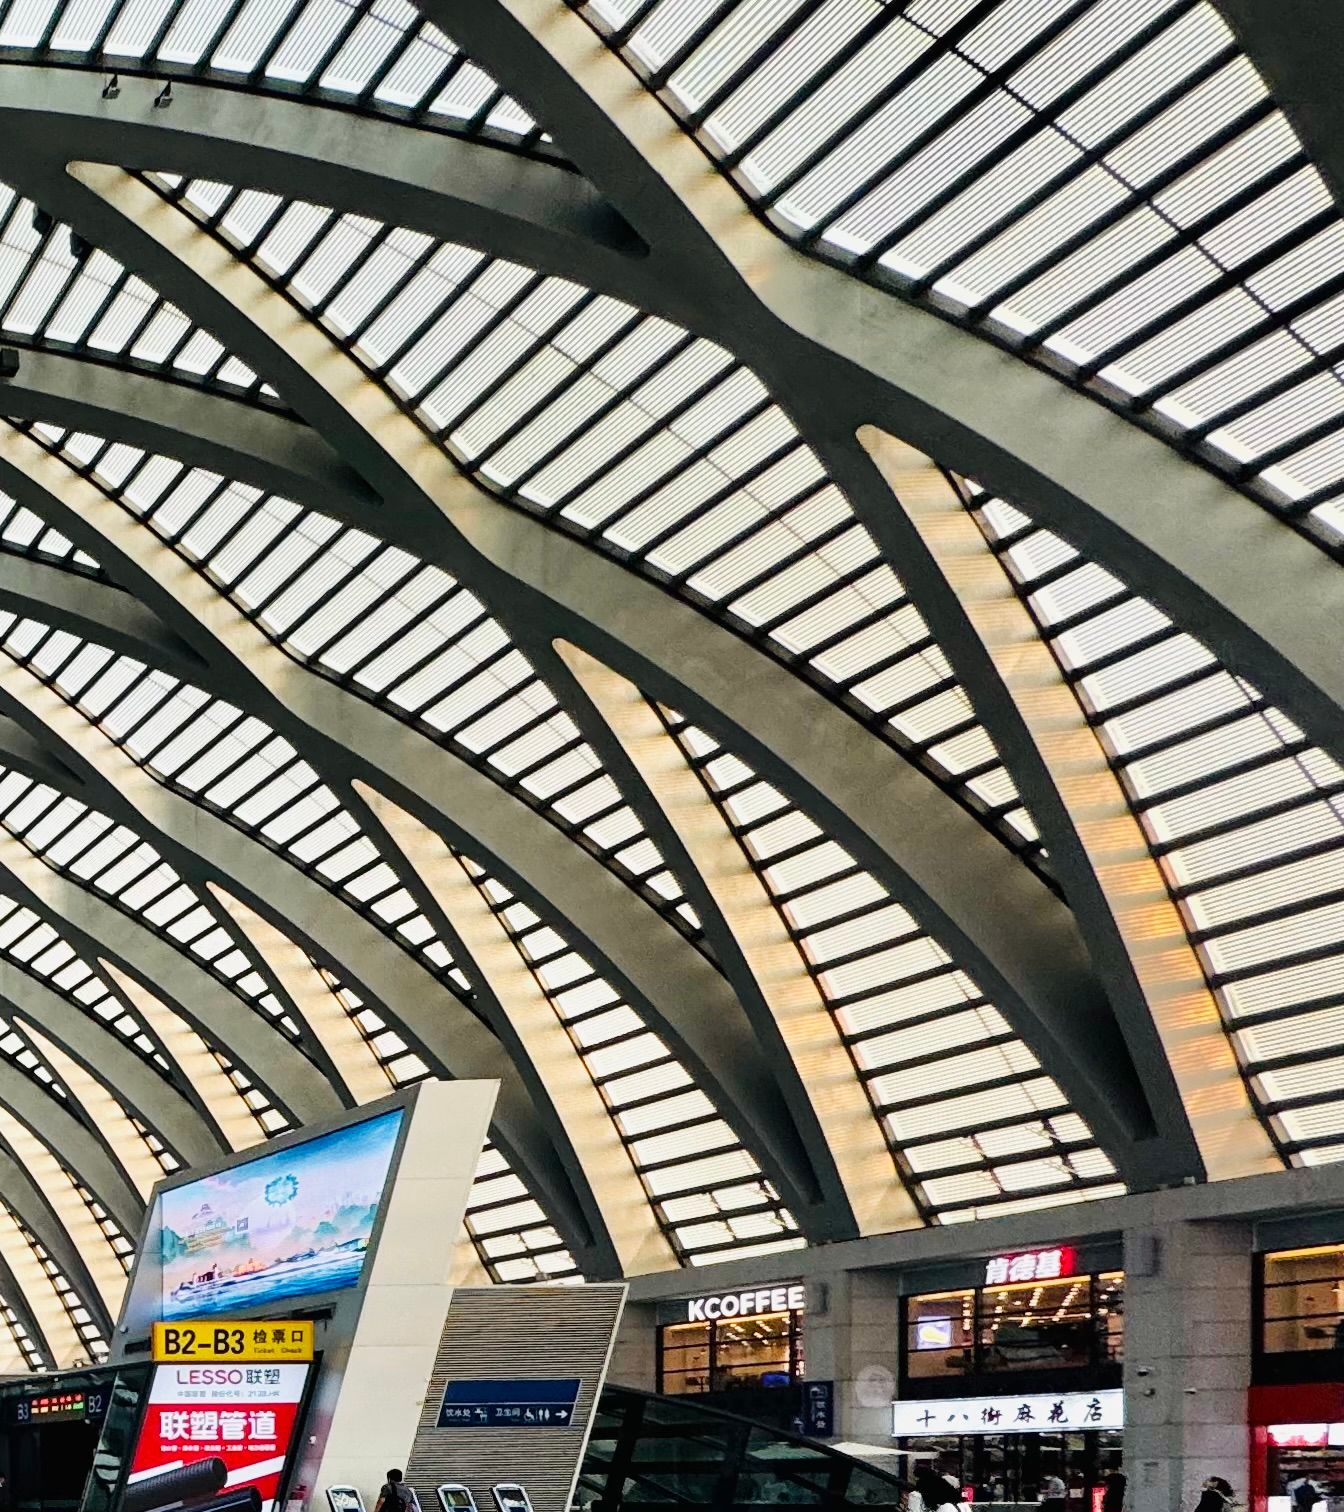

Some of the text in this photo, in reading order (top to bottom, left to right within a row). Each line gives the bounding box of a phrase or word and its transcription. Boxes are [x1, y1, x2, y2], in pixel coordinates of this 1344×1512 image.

[985, 1250, 1062, 1284] 肯德基
[688, 1286, 805, 1322] KCOFFEE
[164, 1328, 304, 1355] B2-B3 检票口
[176, 1368, 281, 1385] LESSO 联塑
[88, 1395, 102, 1413] B2
[495, 1408, 521, 1417] 卫生间
[916, 1398, 1106, 1428] 十八街麻花店
[159, 1410, 278, 1440] 联塑管道
